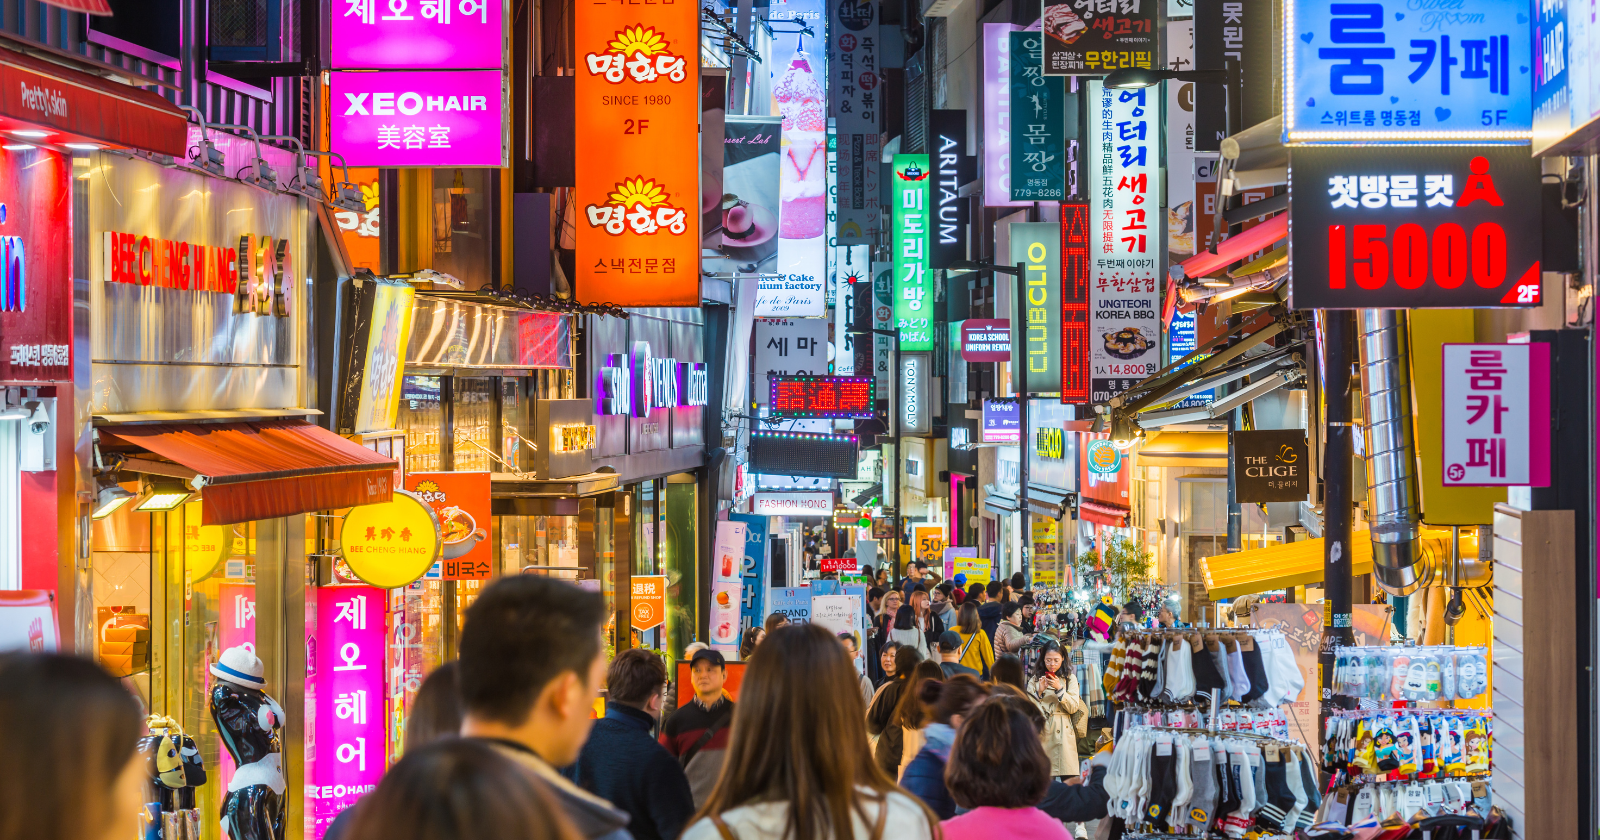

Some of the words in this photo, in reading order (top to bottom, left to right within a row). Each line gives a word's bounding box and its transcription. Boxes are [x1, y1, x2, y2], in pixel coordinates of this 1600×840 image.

[1092, 16, 1151, 39] 생고기
[1318, 4, 1396, 96] 룸
[1408, 35, 1510, 96] 카페
[1085, 50, 1151, 69] 무한리필
[586, 53, 686, 84] 명화당
[602, 95, 639, 106] SINCE
[644, 95, 672, 106] 1980
[624, 119, 650, 135] 2F
[1320, 110, 1376, 127] 스위트룸
[1380, 110, 1421, 127] 명동점
[1481, 110, 1508, 127] 5F
[377, 124, 451, 150] 美容室
[939, 134, 958, 244] ARITAUM
[1014, 189, 1062, 197] 779-8286
[1328, 175, 1418, 208] 첫방문
[1424, 175, 1454, 208] 컷
[586, 204, 686, 236] 명화당
[1117, 173, 1148, 254] 생고기
[902, 188, 925, 311] 미도리가방
[1328, 222, 1507, 290] 15000
[111, 231, 136, 284] BEE
[139, 235, 190, 290] CHENG
[193, 243, 237, 294] HIANG
[594, 258, 676, 274] 스낵전문점
[1096, 259, 1125, 268] 두번째
[1127, 259, 1154, 269] 이야기
[785, 281, 822, 291] factory
[1517, 285, 1539, 302] 2F
[1098, 299, 1152, 308] UNGTEORI
[1096, 310, 1131, 319] KOREA
[1133, 310, 1155, 320] BBQ
[968, 333, 987, 342] KOREA
[988, 333, 1009, 341] SCHOOL
[965, 343, 991, 352] UNIFORM
[906, 360, 916, 428] TONYMOLY
[1465, 350, 1510, 478] 룸카페
[1243, 456, 1268, 465] THE
[1245, 466, 1298, 478] CLIGE
[1449, 466, 1464, 479] 5F
[759, 499, 800, 509] FASHION
[350, 545, 364, 553] BEE
[365, 545, 396, 554] CHENG
[398, 546, 427, 555] HIANG
[333, 594, 367, 772] 제오헤어
